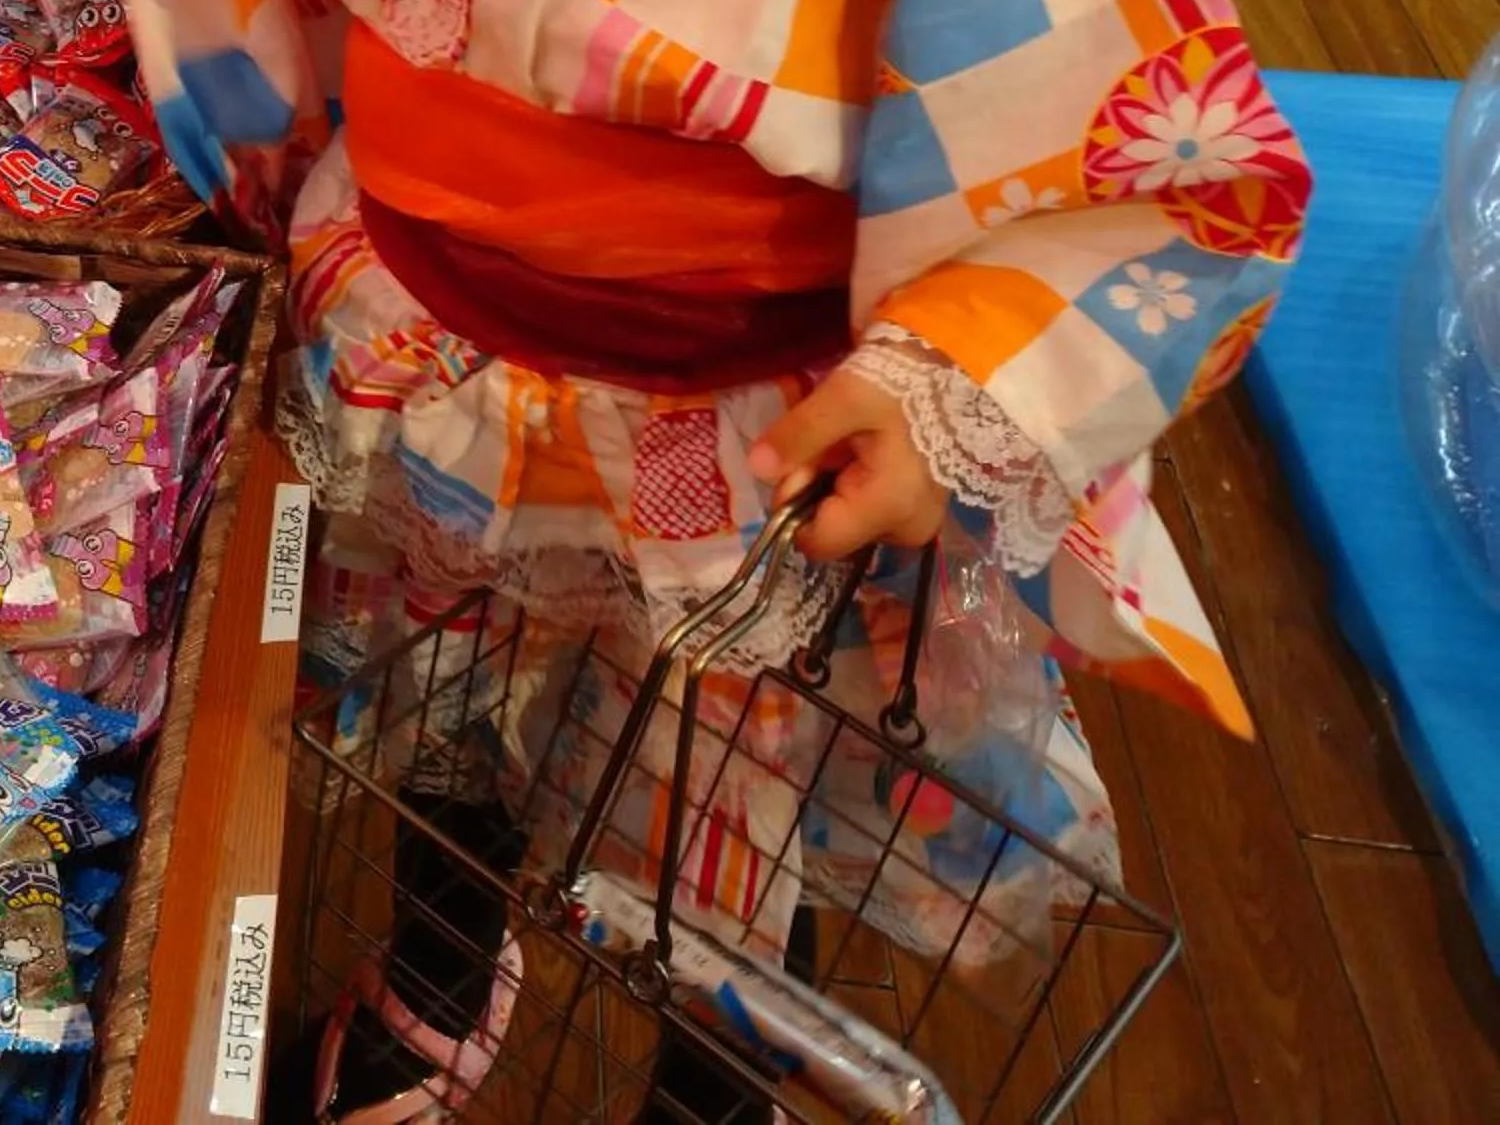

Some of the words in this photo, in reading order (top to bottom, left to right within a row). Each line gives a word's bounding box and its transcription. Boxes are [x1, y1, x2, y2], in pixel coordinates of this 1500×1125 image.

[271, 503, 304, 617] 15円税込み
[223, 922, 269, 1082] 15円税込み
